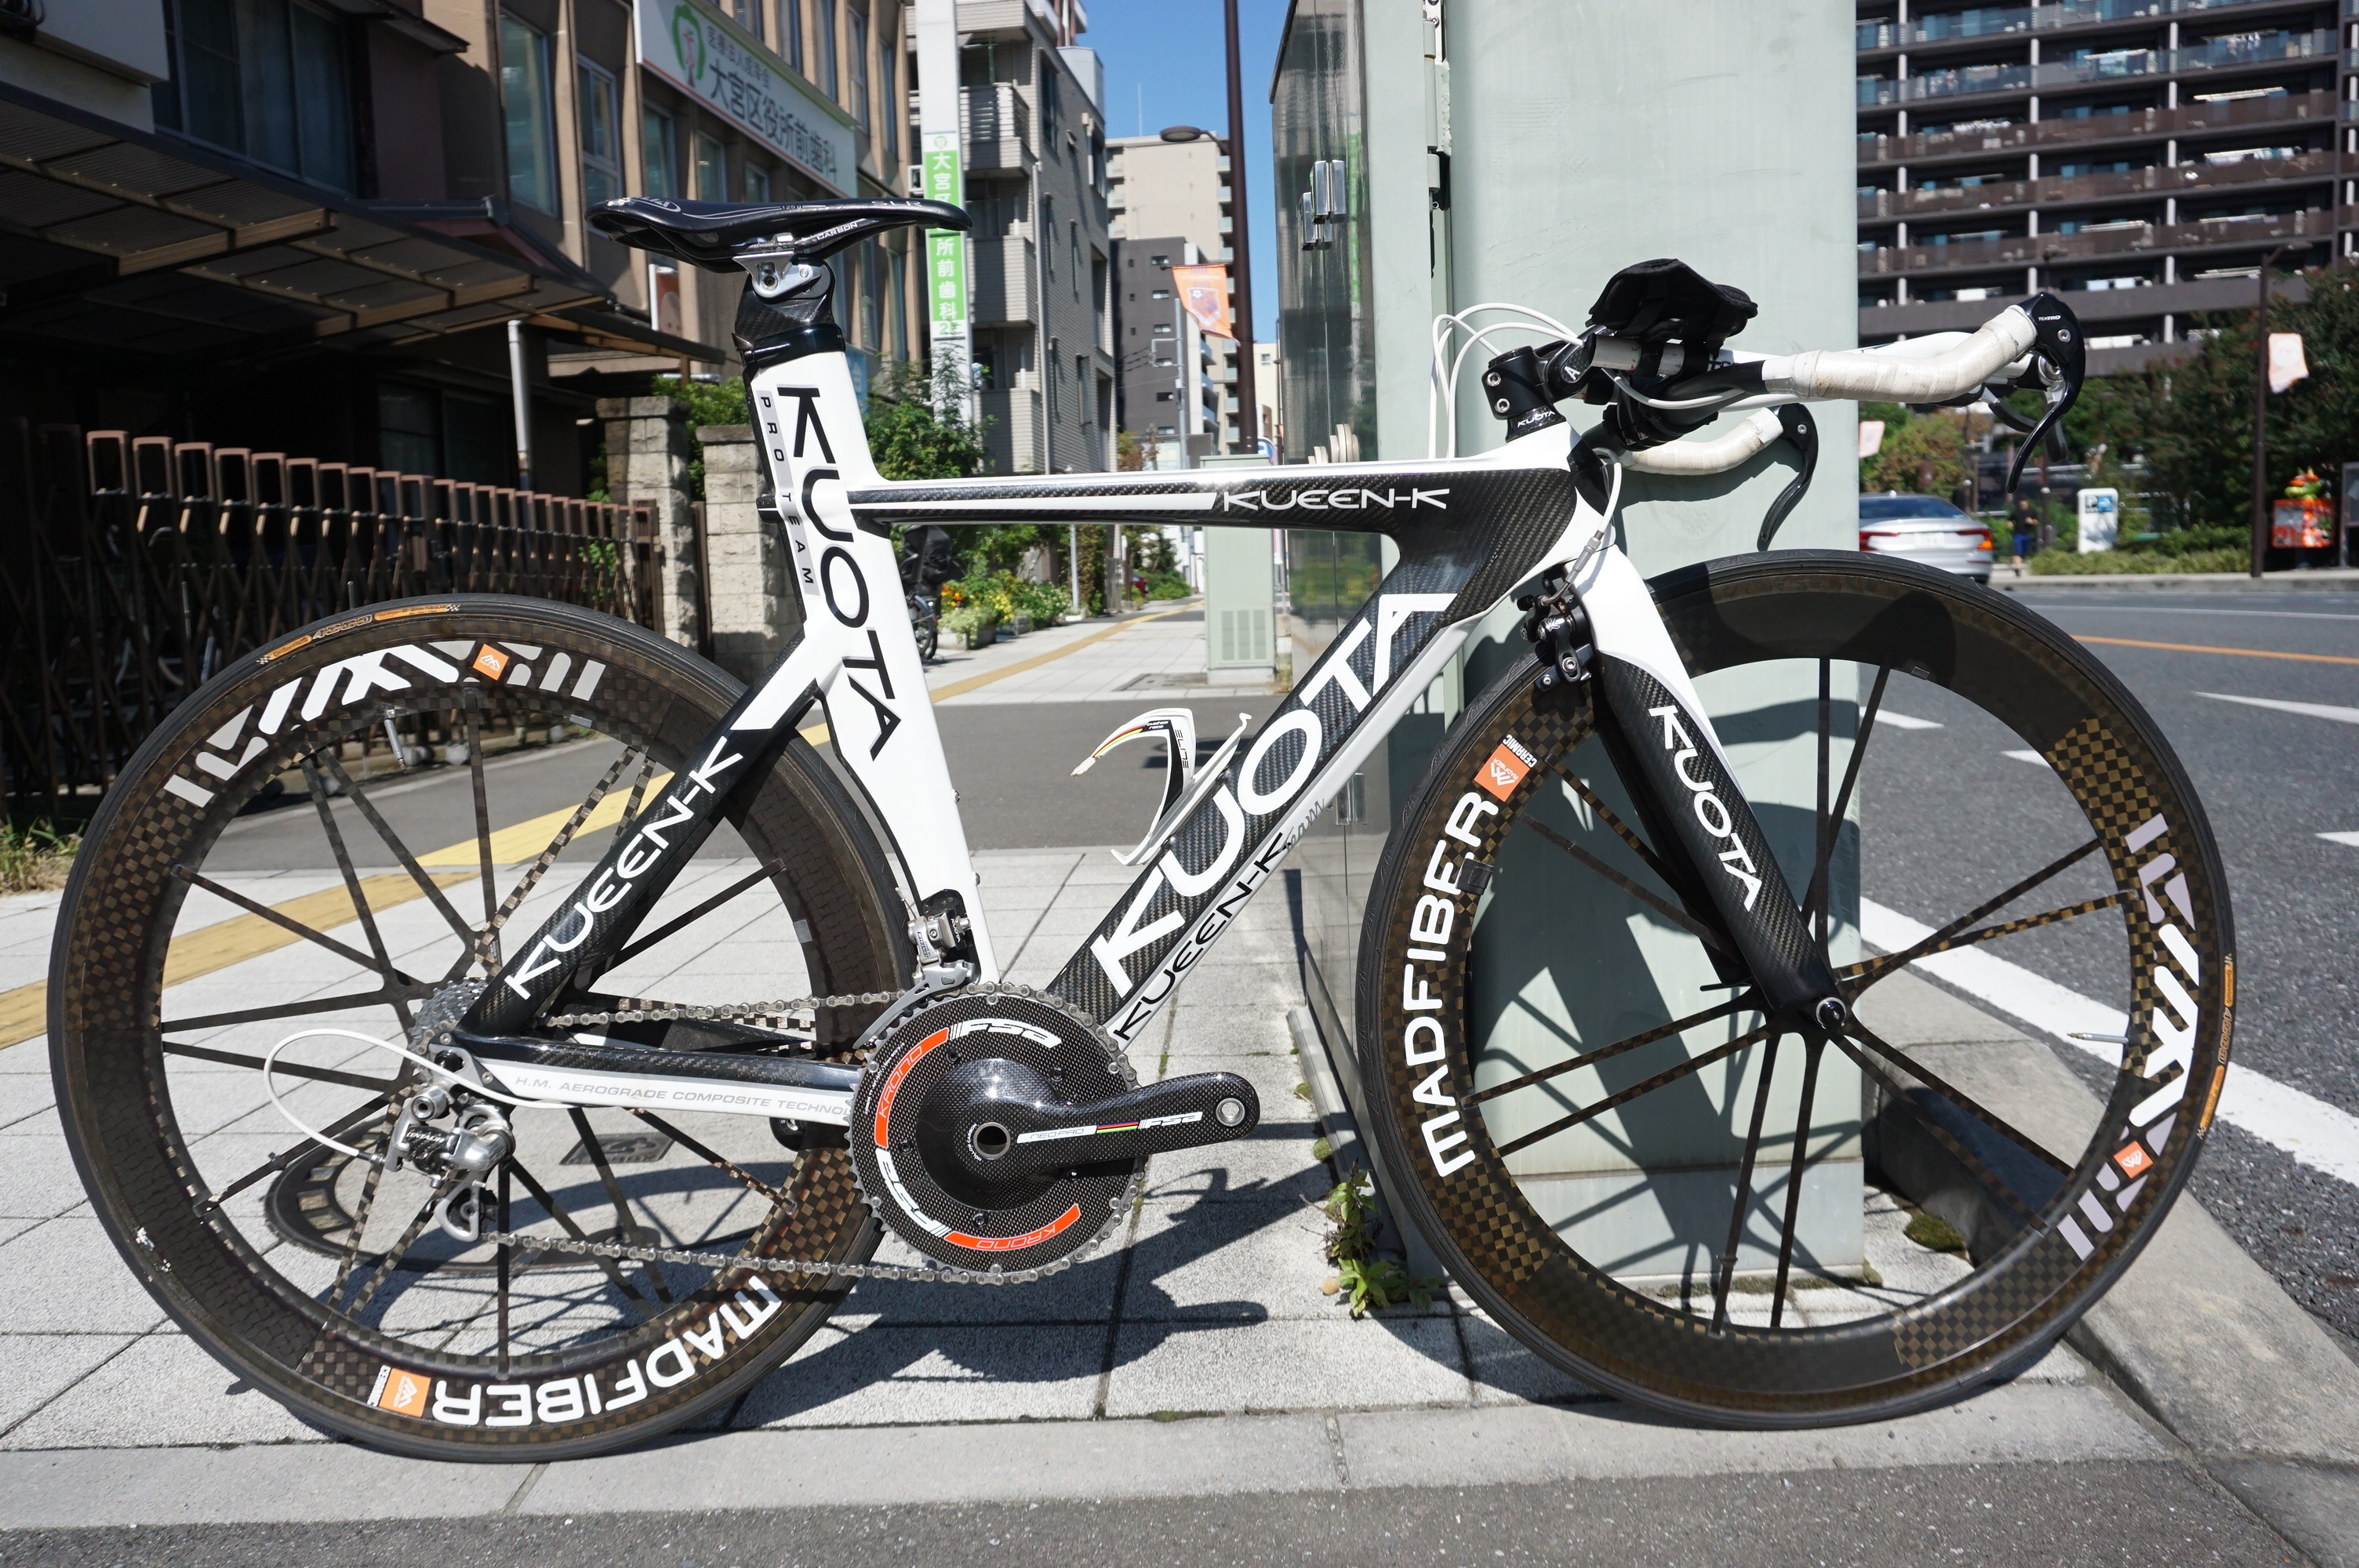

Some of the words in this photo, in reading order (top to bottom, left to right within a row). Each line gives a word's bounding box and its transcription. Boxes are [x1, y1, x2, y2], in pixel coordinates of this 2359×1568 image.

[709, 58, 837, 183] 大宮区役所前歯科
[816, 223, 858, 241] CARBON
[1518, 410, 1556, 428] KUOTA
[761, 396, 785, 463] PRO
[782, 492, 814, 585] TEAM
[1223, 488, 1450, 512] KUEEN-K
[776, 386, 902, 761] KUOTA
[1175, 729, 1189, 768] ELITE
[1503, 734, 1537, 768] CERAMIC
[1493, 757, 1519, 781] MADFIBER
[1090, 593, 1458, 999] KUOTA
[1649, 706, 1763, 912] KUOTA
[504, 736, 743, 1000] KUEEN-K
[951, 918, 961, 943] KUOTA
[1113, 832, 1292, 1040] KUEEN-K
[1402, 792, 1499, 1177] MADFIBER
[958, 1018, 1062, 1048] FSA
[515, 1076, 552, 1090] H.M.
[559, 1083, 667, 1100] AEROGRADE
[672, 1091, 771, 1108] COMPOSITE
[878, 1044, 924, 1119] KRONO
[967, 1123, 977, 1143] CARBON
[1030, 1131, 1056, 1140] NEO
[1144, 1112, 1203, 1129] FSA
[875, 1148, 947, 1236] FSA
[976, 1224, 1056, 1250] KRONO
[432, 1275, 783, 1427] MADFIBER
